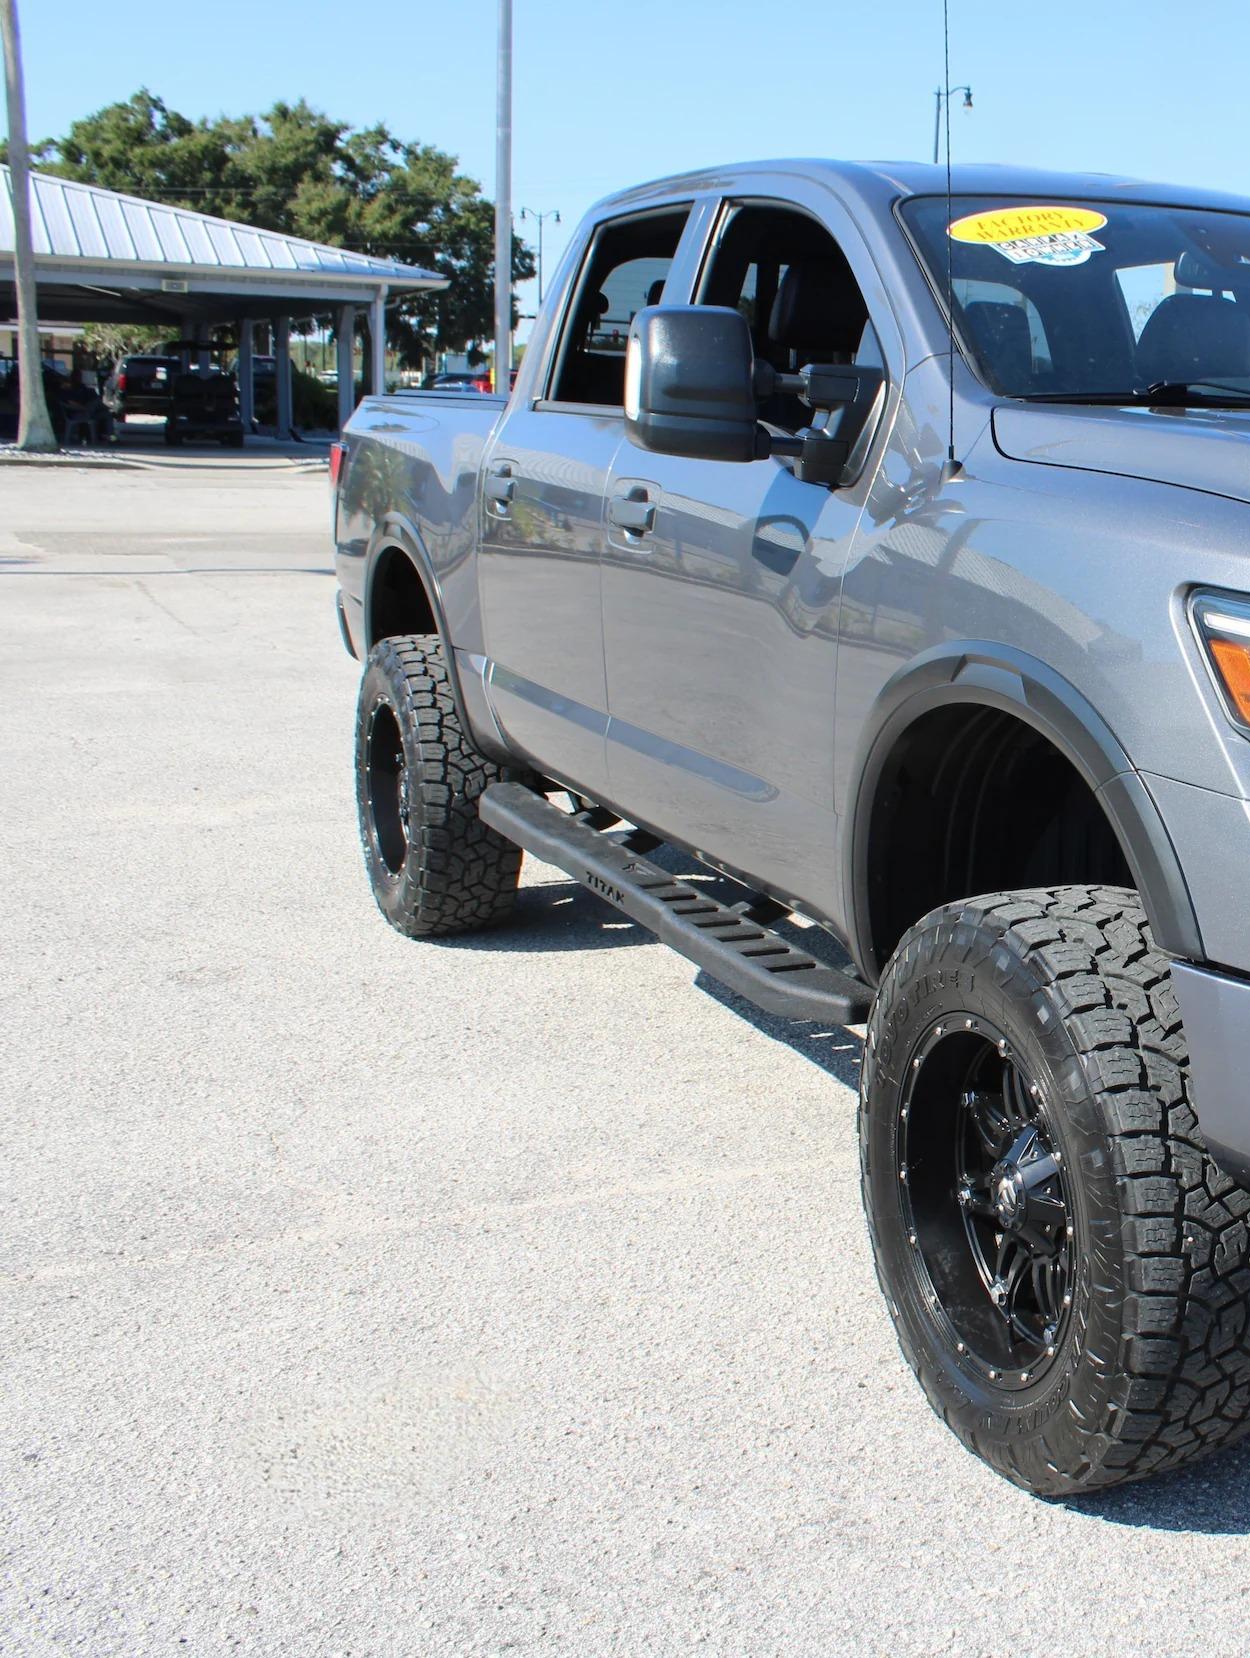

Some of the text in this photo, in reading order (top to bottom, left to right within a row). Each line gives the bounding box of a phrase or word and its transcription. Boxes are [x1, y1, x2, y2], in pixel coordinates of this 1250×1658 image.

[977, 211, 1064, 231] FACTORY
[977, 218, 1084, 241] WARRANTY
[585, 871, 625, 904] TITAN
